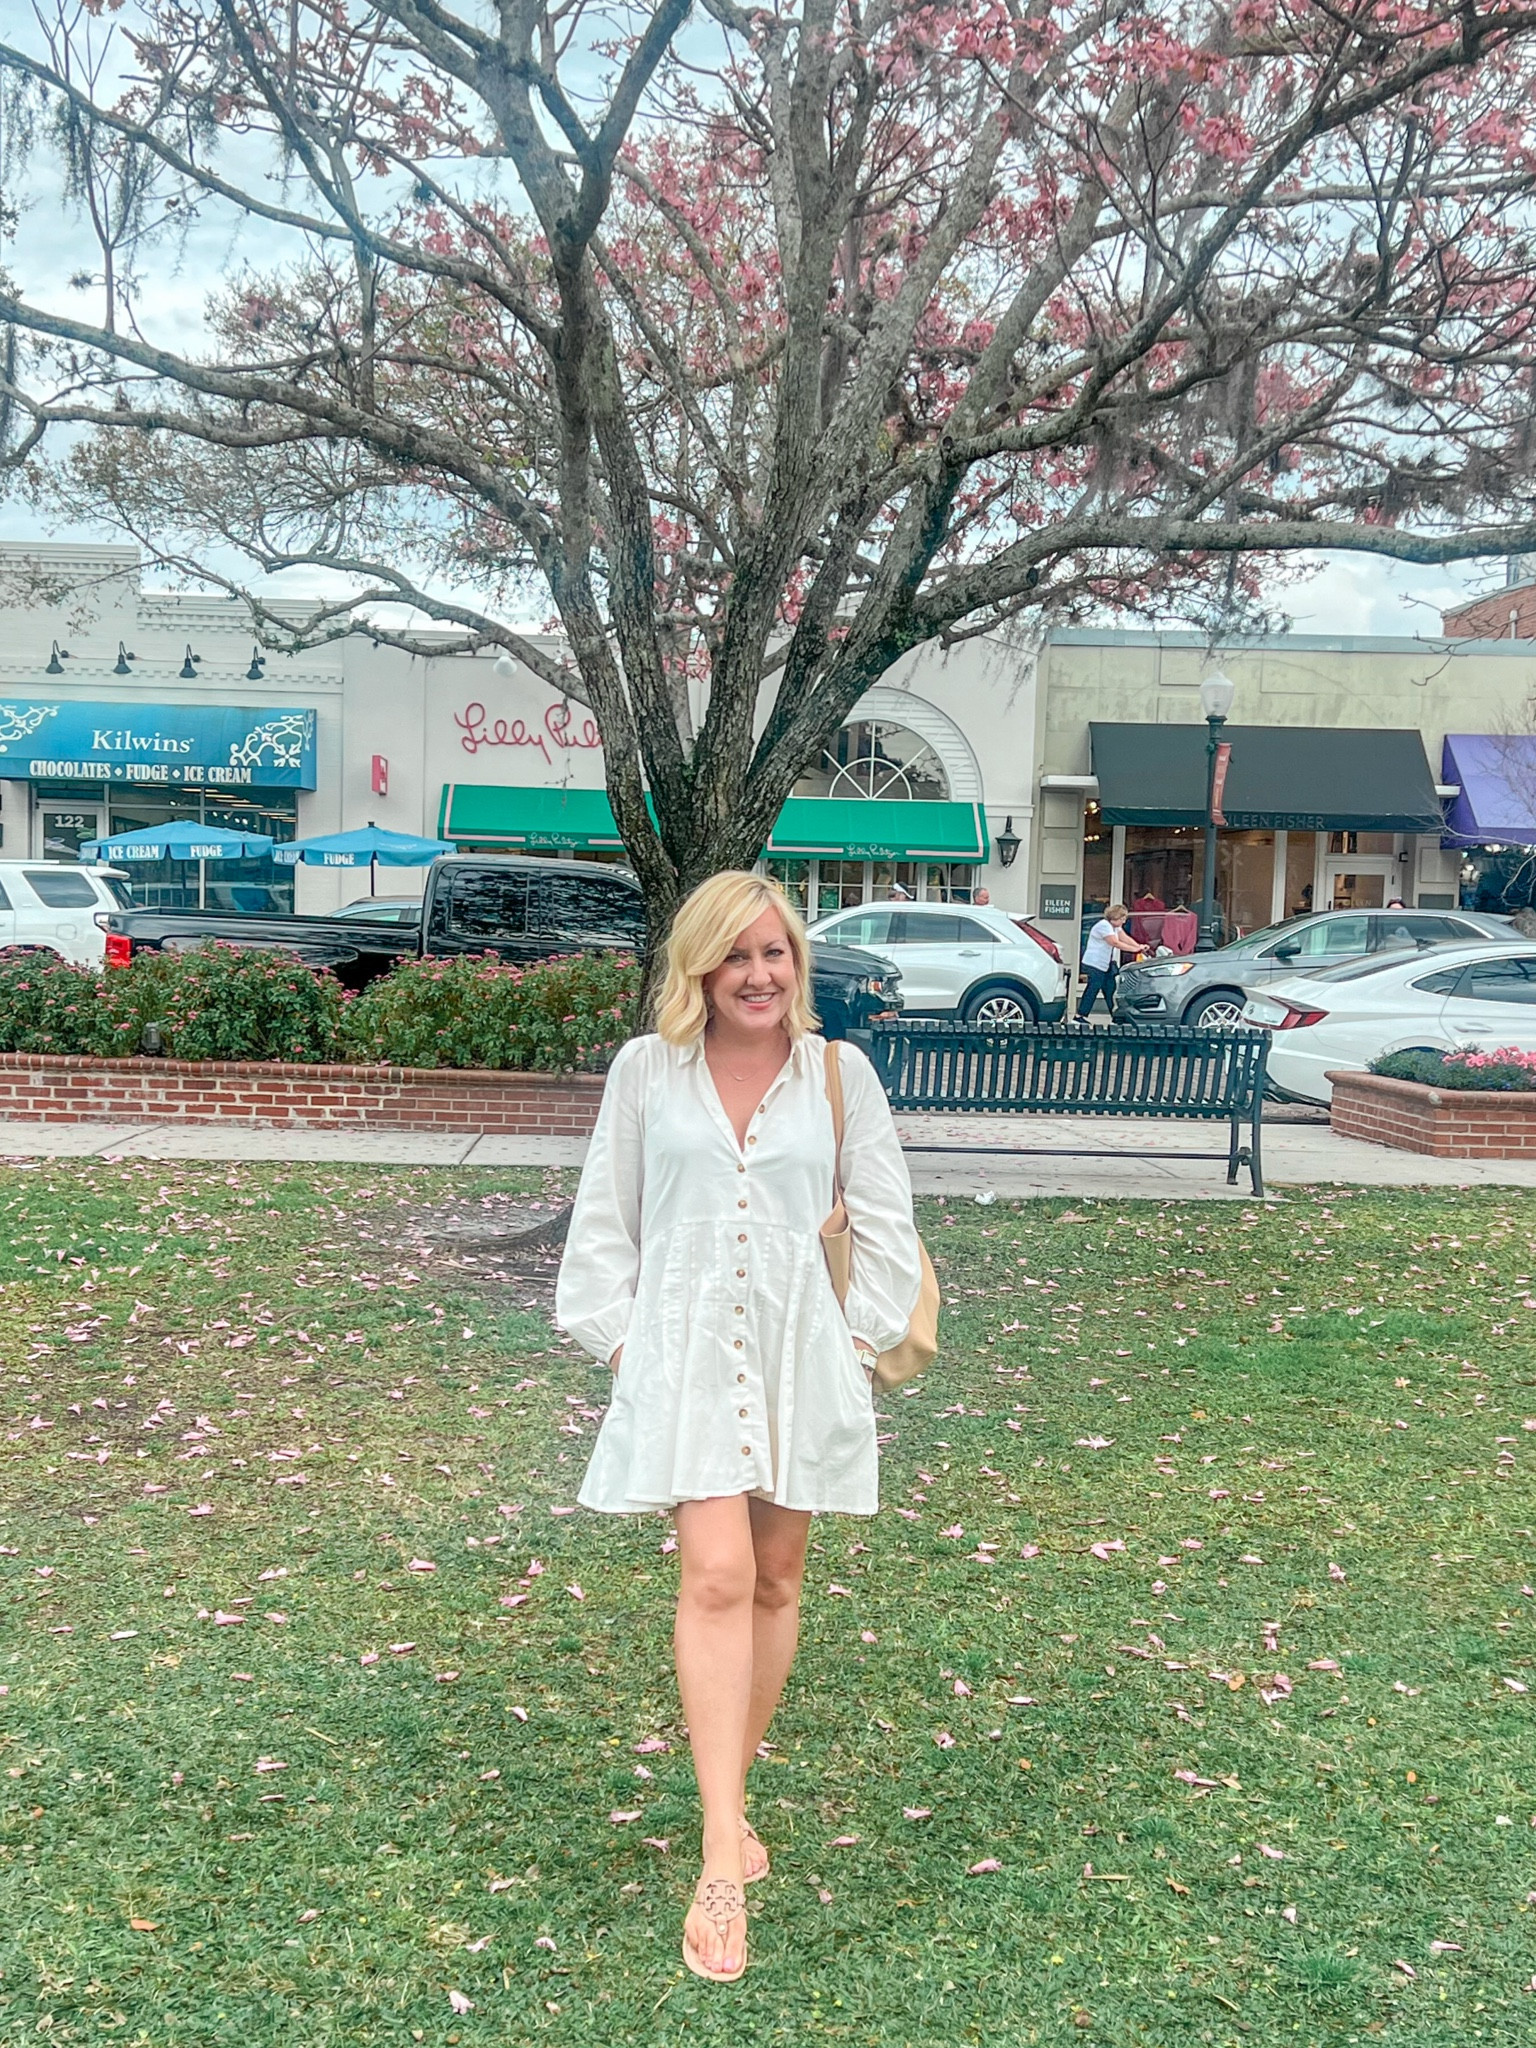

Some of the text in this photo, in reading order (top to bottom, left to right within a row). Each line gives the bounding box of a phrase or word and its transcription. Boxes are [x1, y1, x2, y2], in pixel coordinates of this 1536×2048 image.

[454, 702, 552, 765] Lilly
[92, 730, 194, 753] Kilwins
[29, 760, 252, 784] CHOCOLATES FUDGE ICE CREAM
[55, 815, 85, 828] 122
[1224, 813, 1325, 829] ILEEN FISHER
[108, 846, 124, 860] ICE
[126, 845, 159, 859] CREAM
[190, 844, 223, 858] FUDGE
[323, 852, 355, 865] FUDGE
[1044, 906, 1070, 914] FISHER
